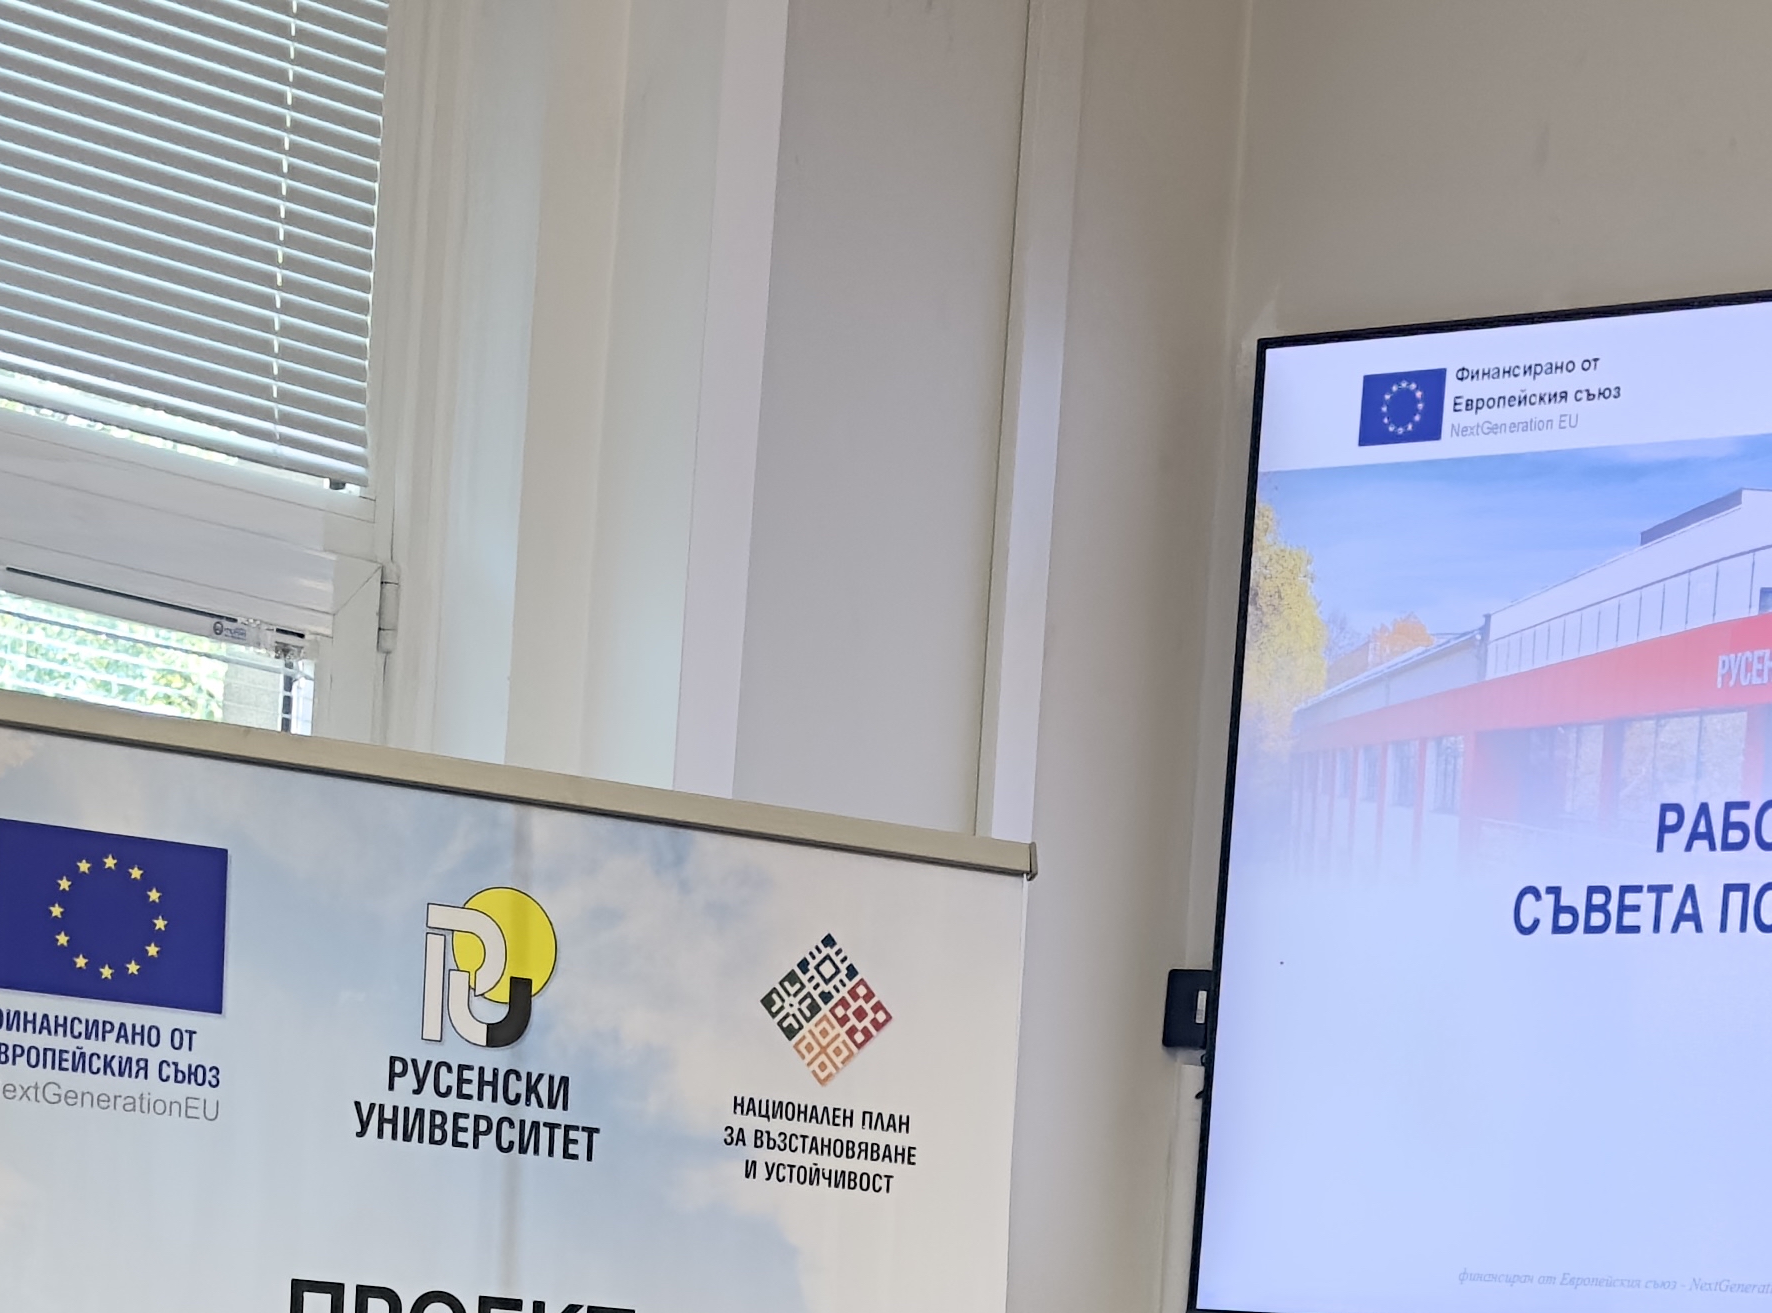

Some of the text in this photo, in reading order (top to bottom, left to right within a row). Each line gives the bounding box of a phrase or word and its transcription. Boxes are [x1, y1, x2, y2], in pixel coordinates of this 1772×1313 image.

[1455, 357, 1600, 382] Финансирано от
[1453, 386, 1621, 415] Европейския съюз
[1450, 414, 1578, 438] NextGeneration EU
[1513, 883, 1702, 936] СЪВЕТА
[170, 1028, 197, 1052] ОТ
[158, 1059, 220, 1089] СЪЮЗ
[386, 1057, 570, 1113] РУСЕНСКИ
[354, 1099, 600, 1163] УНИВЕРСИТЕТ
[733, 1095, 910, 1134] НАЦИОНАЛЕН ПЛАН
[723, 1126, 917, 1166] ЗА ВЪЗСТАНОВЯВАНЕ
[744, 1159, 894, 1194] И УСТОЙЧИВОСТ
